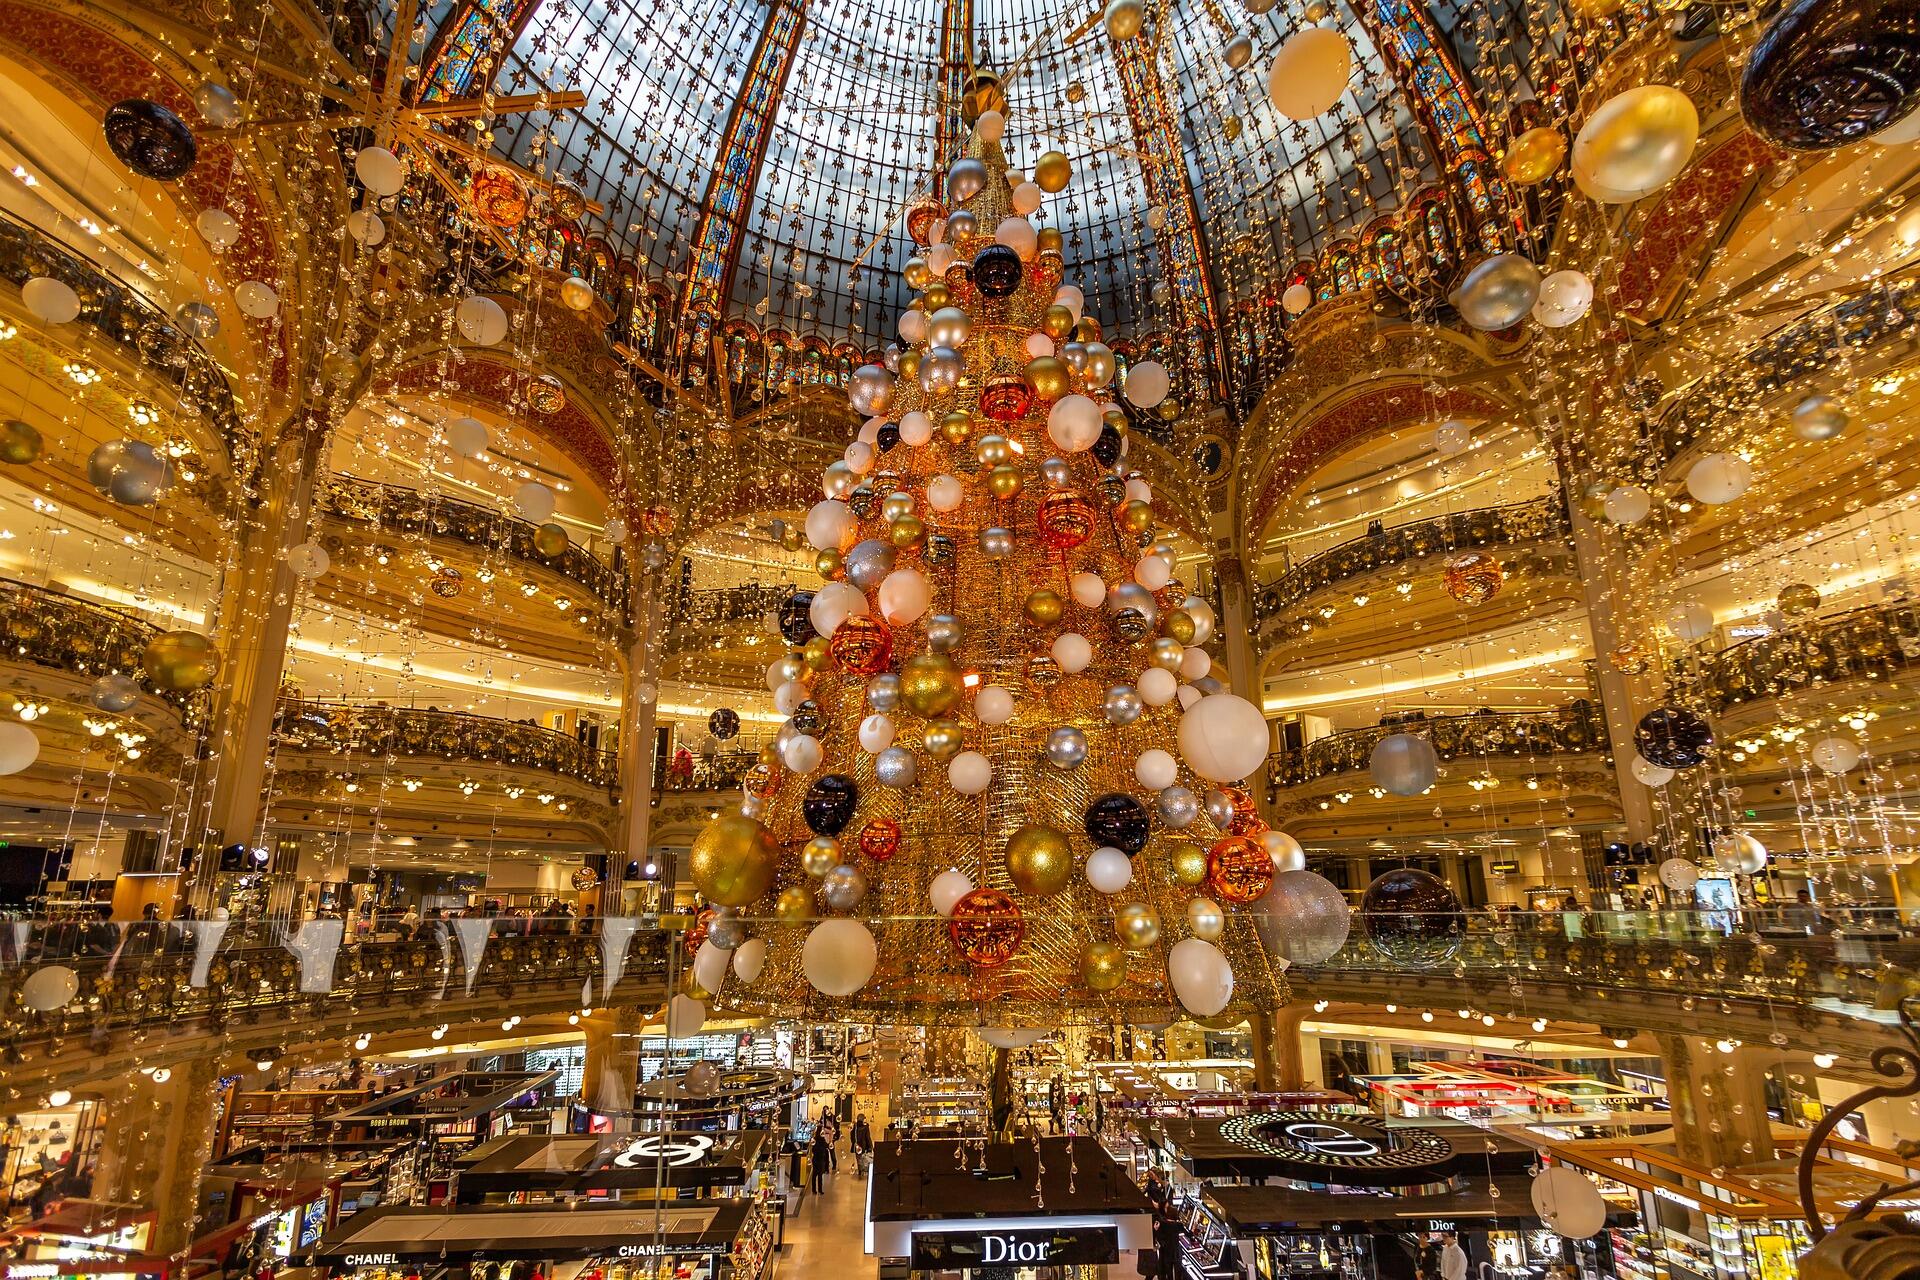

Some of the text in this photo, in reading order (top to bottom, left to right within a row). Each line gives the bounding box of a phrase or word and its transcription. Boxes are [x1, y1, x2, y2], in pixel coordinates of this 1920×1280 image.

[1594, 1097, 1640, 1105] BVLGARI
[1429, 1220, 1455, 1231] Dior
[619, 1244, 667, 1257] CHANEL
[981, 1235, 1049, 1262] Dior
[345, 1253, 399, 1266] CHANEL
